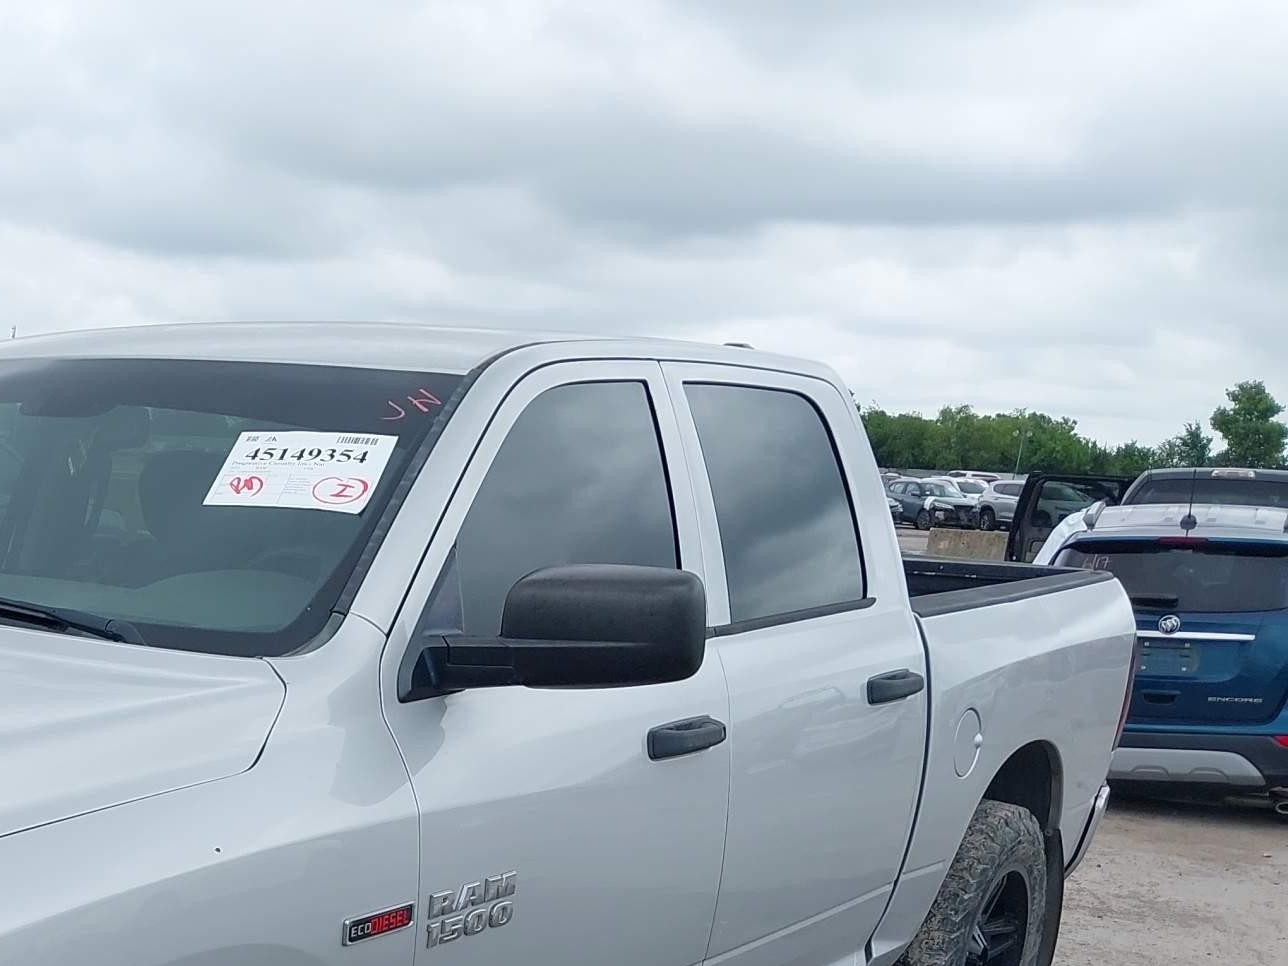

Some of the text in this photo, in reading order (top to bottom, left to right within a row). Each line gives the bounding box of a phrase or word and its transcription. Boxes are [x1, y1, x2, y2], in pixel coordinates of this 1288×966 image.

[245, 447, 368, 464] 45149354
[1207, 696, 1264, 704] ENCORE
[427, 869, 517, 920] RAM
[350, 907, 410, 938] ECODIESEL
[426, 900, 514, 949] 1500
